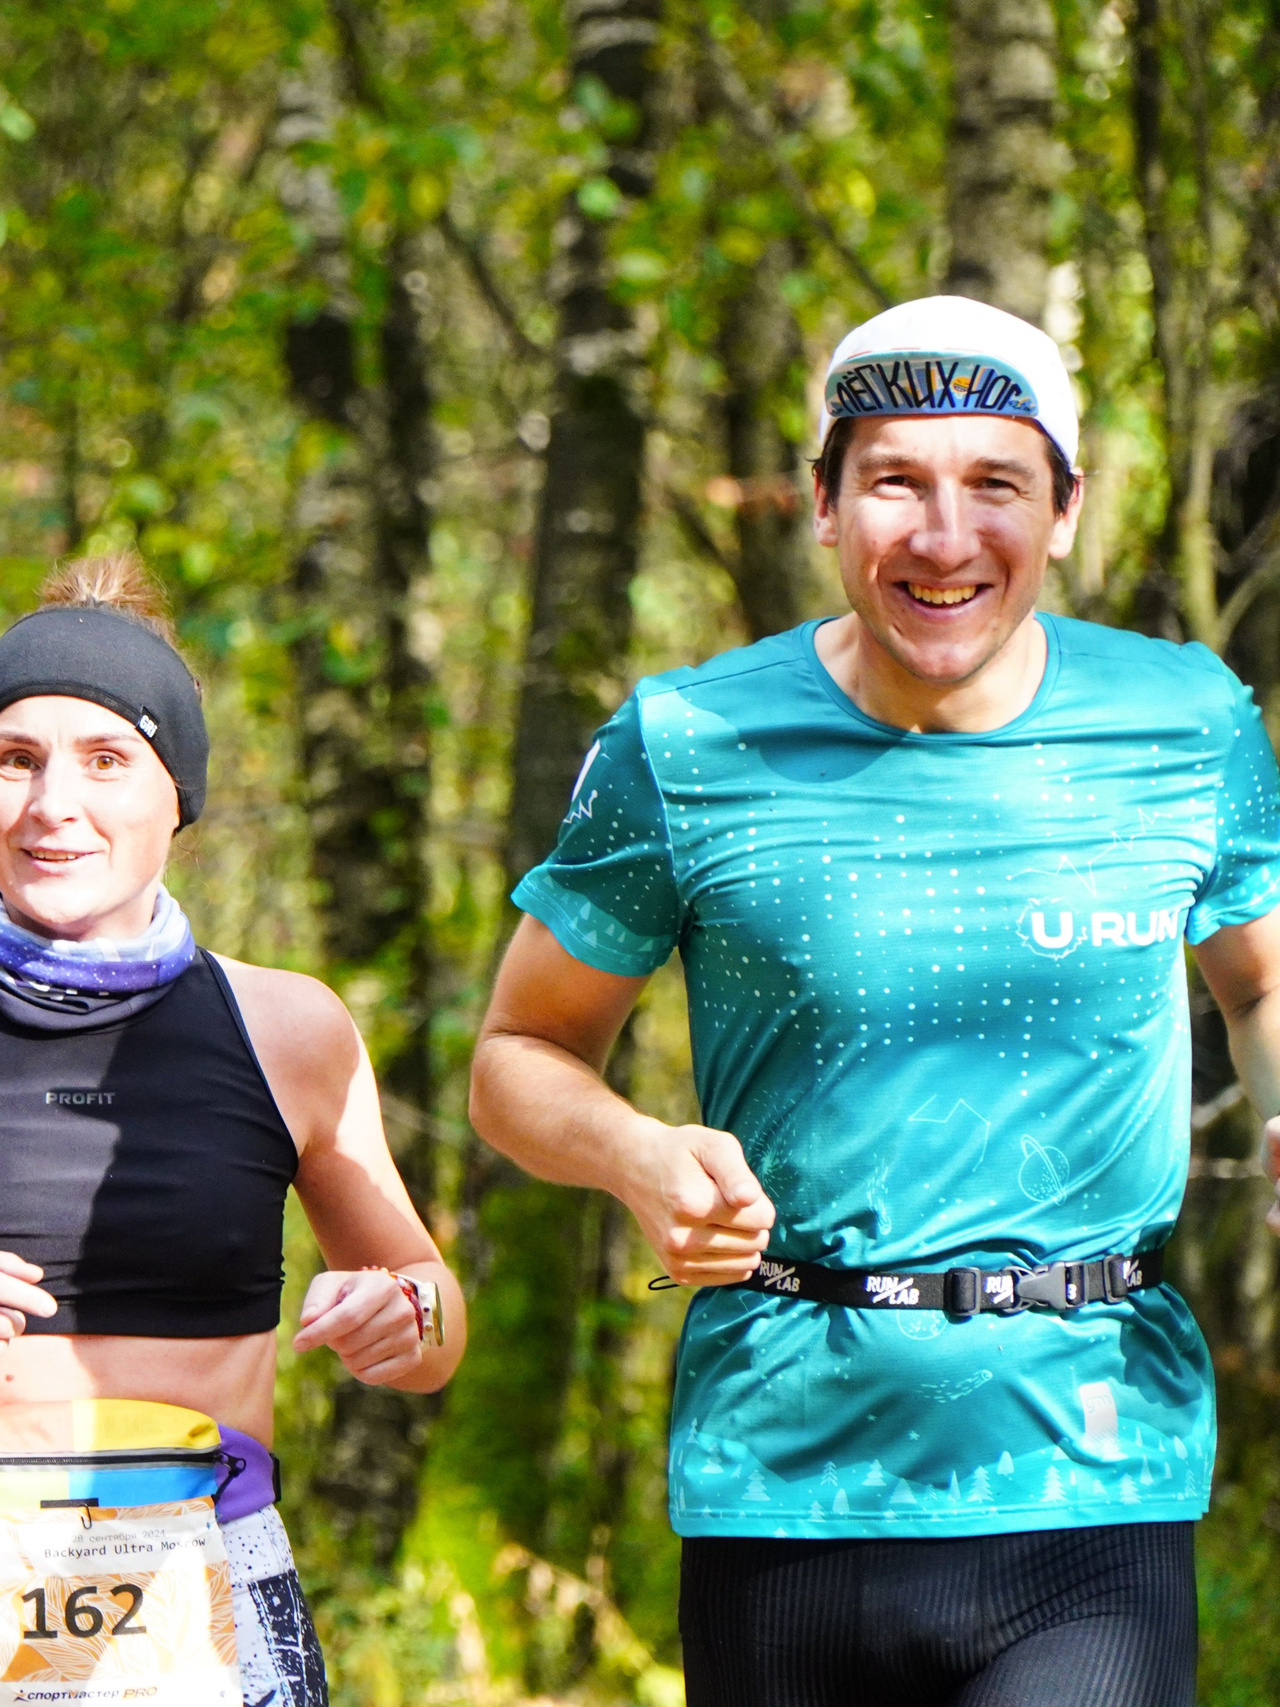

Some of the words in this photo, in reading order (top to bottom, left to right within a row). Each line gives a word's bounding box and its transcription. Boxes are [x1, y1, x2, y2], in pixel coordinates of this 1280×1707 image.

[963, 364, 1023, 411] НОГ
[1091, 908, 1181, 947] RUN
[45, 1092, 116, 1105] PROFIT
[759, 1260, 784, 1278] RUN
[776, 1276, 800, 1292] LAB
[865, 1275, 899, 1293] RUN
[888, 1288, 920, 1305] LAB
[44, 1544, 107, 1560] Backyard
[114, 1542, 154, 1554] Ultra
[22, 1583, 147, 1639] 162
[123, 1686, 158, 1699] PRO
